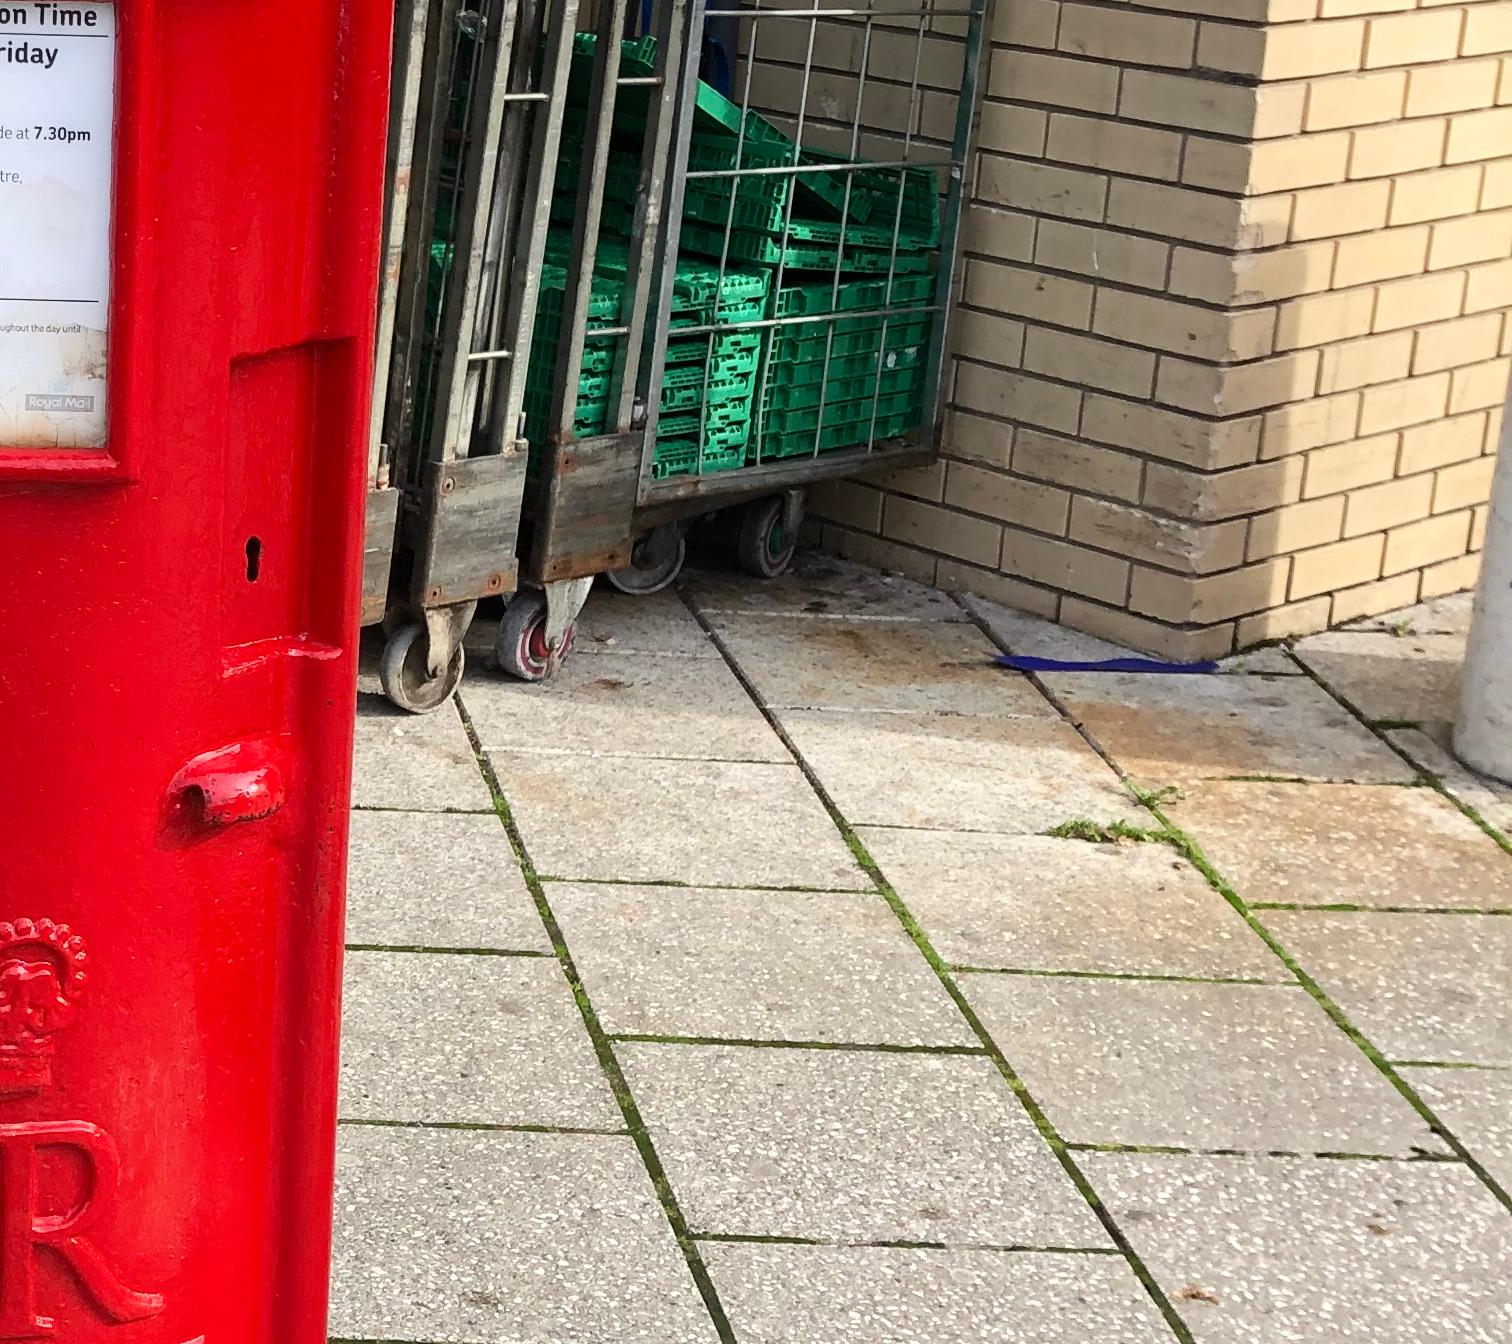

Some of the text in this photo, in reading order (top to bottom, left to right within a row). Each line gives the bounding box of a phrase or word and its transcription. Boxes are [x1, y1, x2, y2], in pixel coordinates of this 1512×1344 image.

[34, 3, 97, 27] Time
[16, 127, 30, 140] at
[34, 127, 90, 143] 7.30pm
[31, 324, 44, 332] the
[46, 324, 60, 334] day
[63, 324, 80, 333] until
[29, 397, 91, 408] Royal Mal
